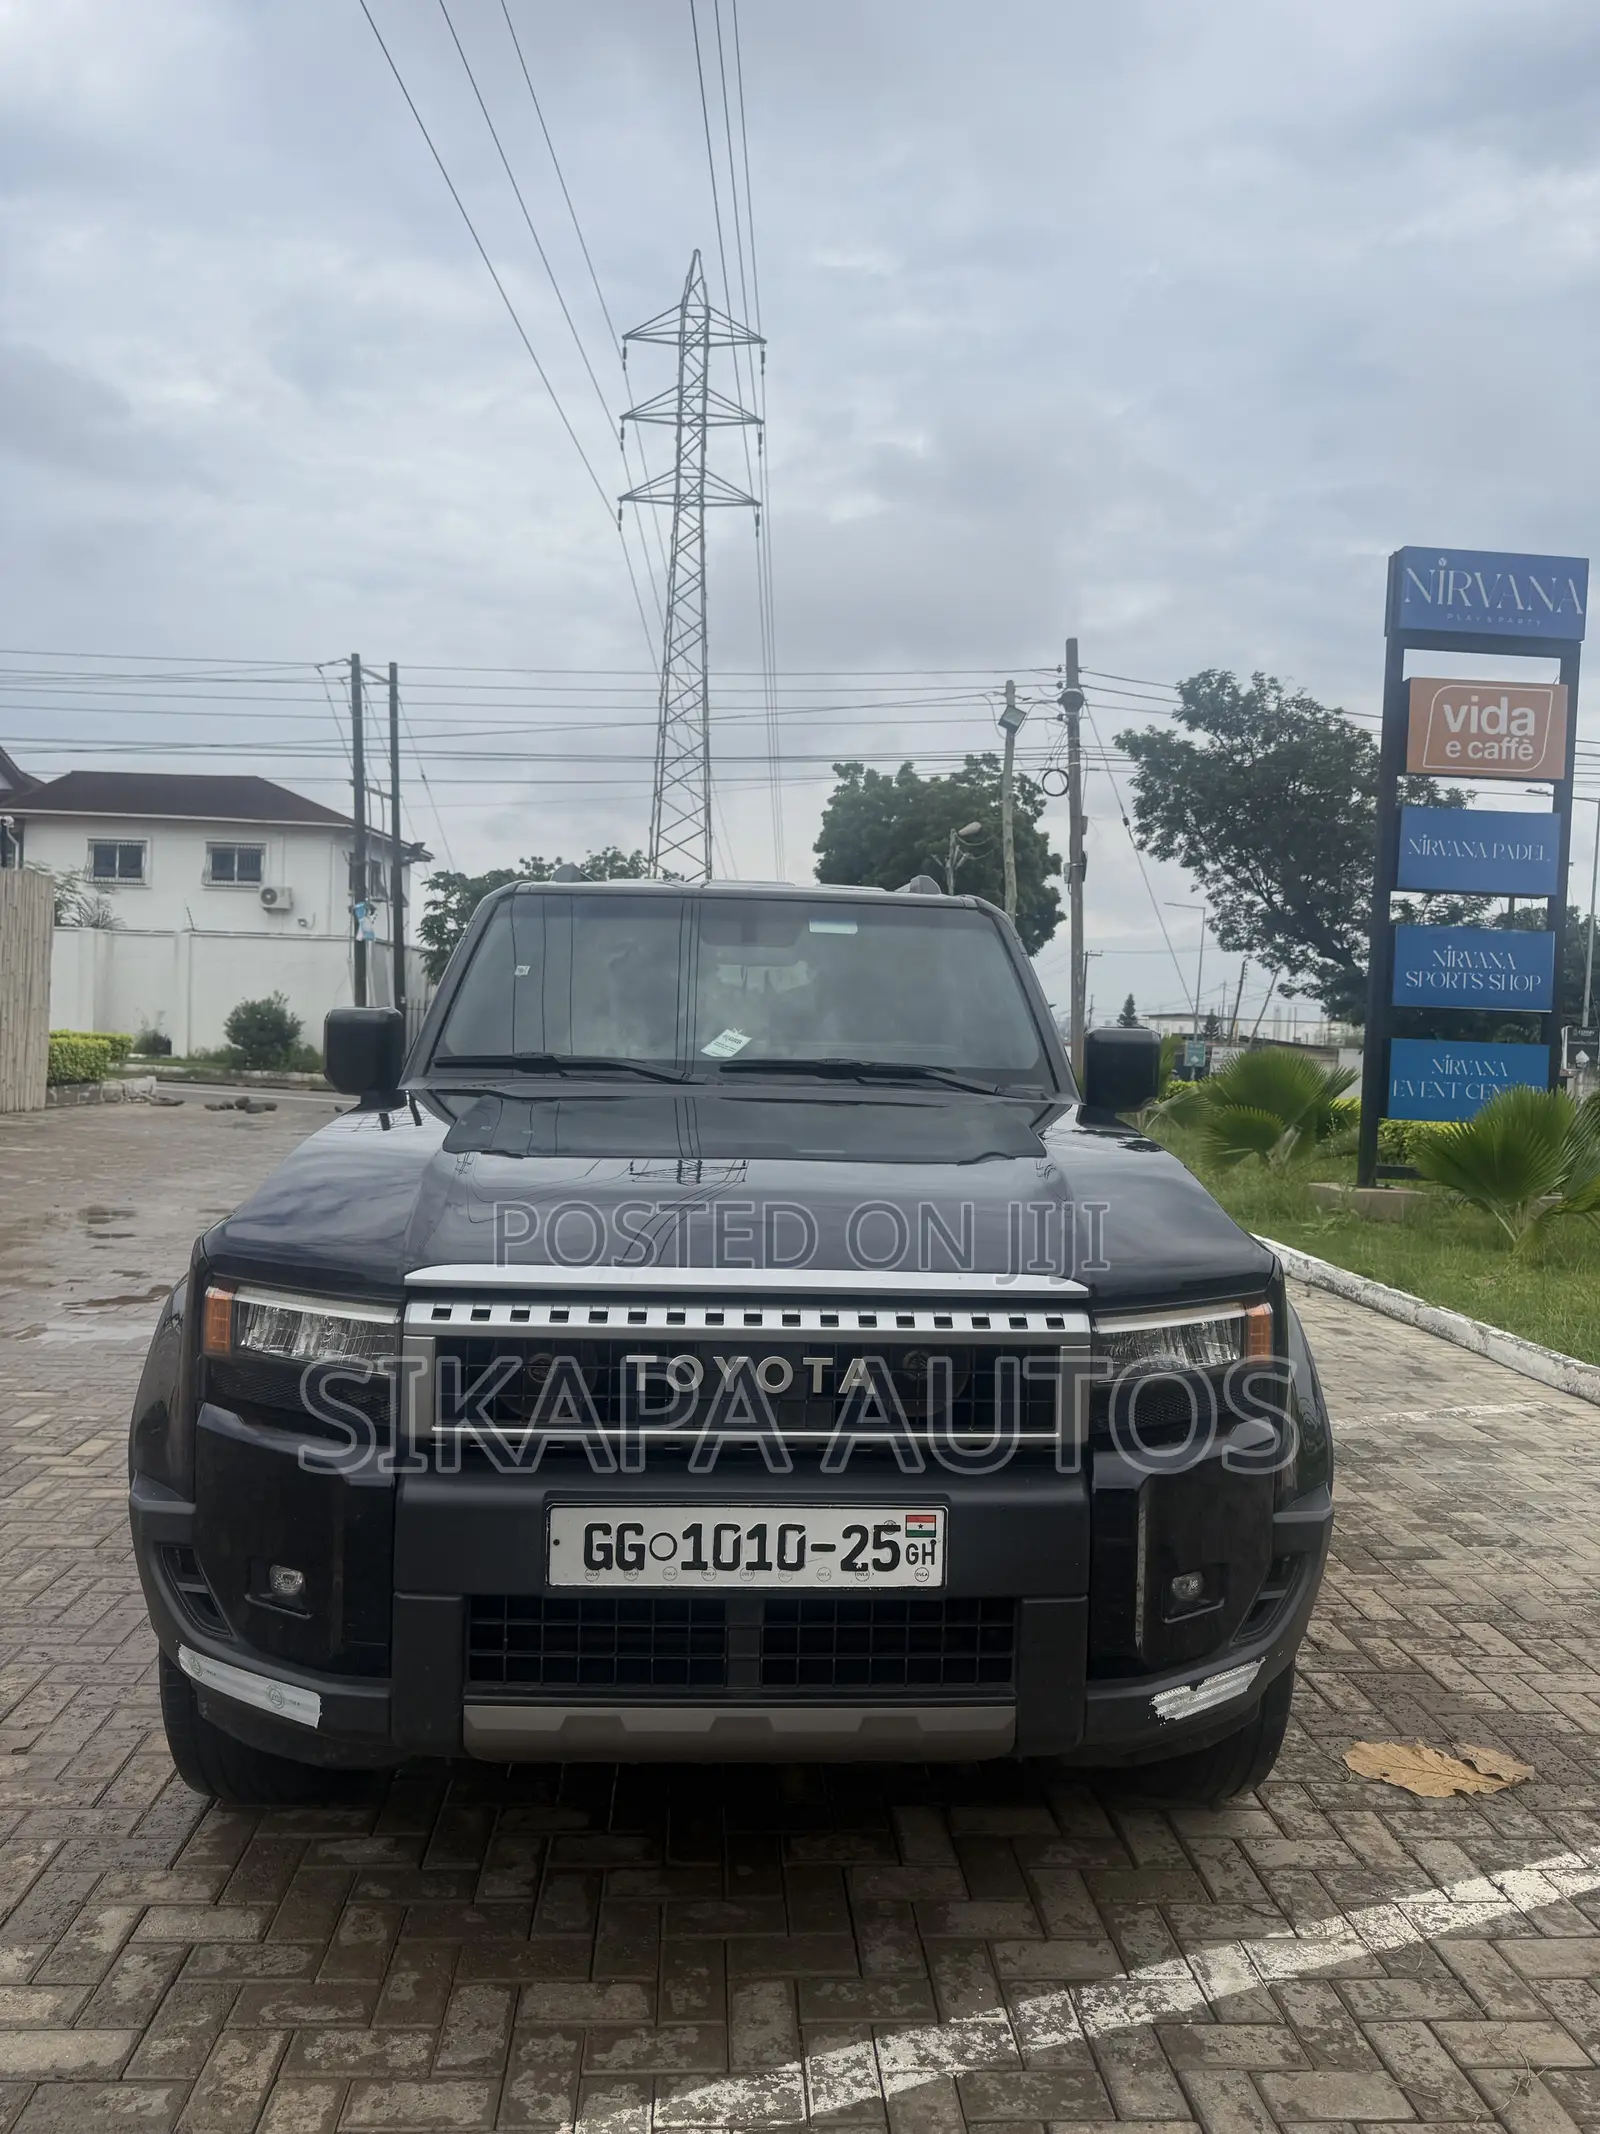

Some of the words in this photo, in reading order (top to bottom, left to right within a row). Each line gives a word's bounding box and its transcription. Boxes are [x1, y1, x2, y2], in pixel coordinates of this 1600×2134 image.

[1443, 695, 1535, 737] vida
[1445, 740, 1461, 758] e
[1492, 843, 1550, 862] PADEL
[1405, 971, 1483, 990] SPORTS
[1489, 974, 1541, 992] SHOP
[1392, 1078, 1461, 1099] EVENT
[625, 1354, 875, 1394] TOYOTA
[680, 1522, 901, 1572] 1010-25
[905, 1542, 936, 1566] GH
